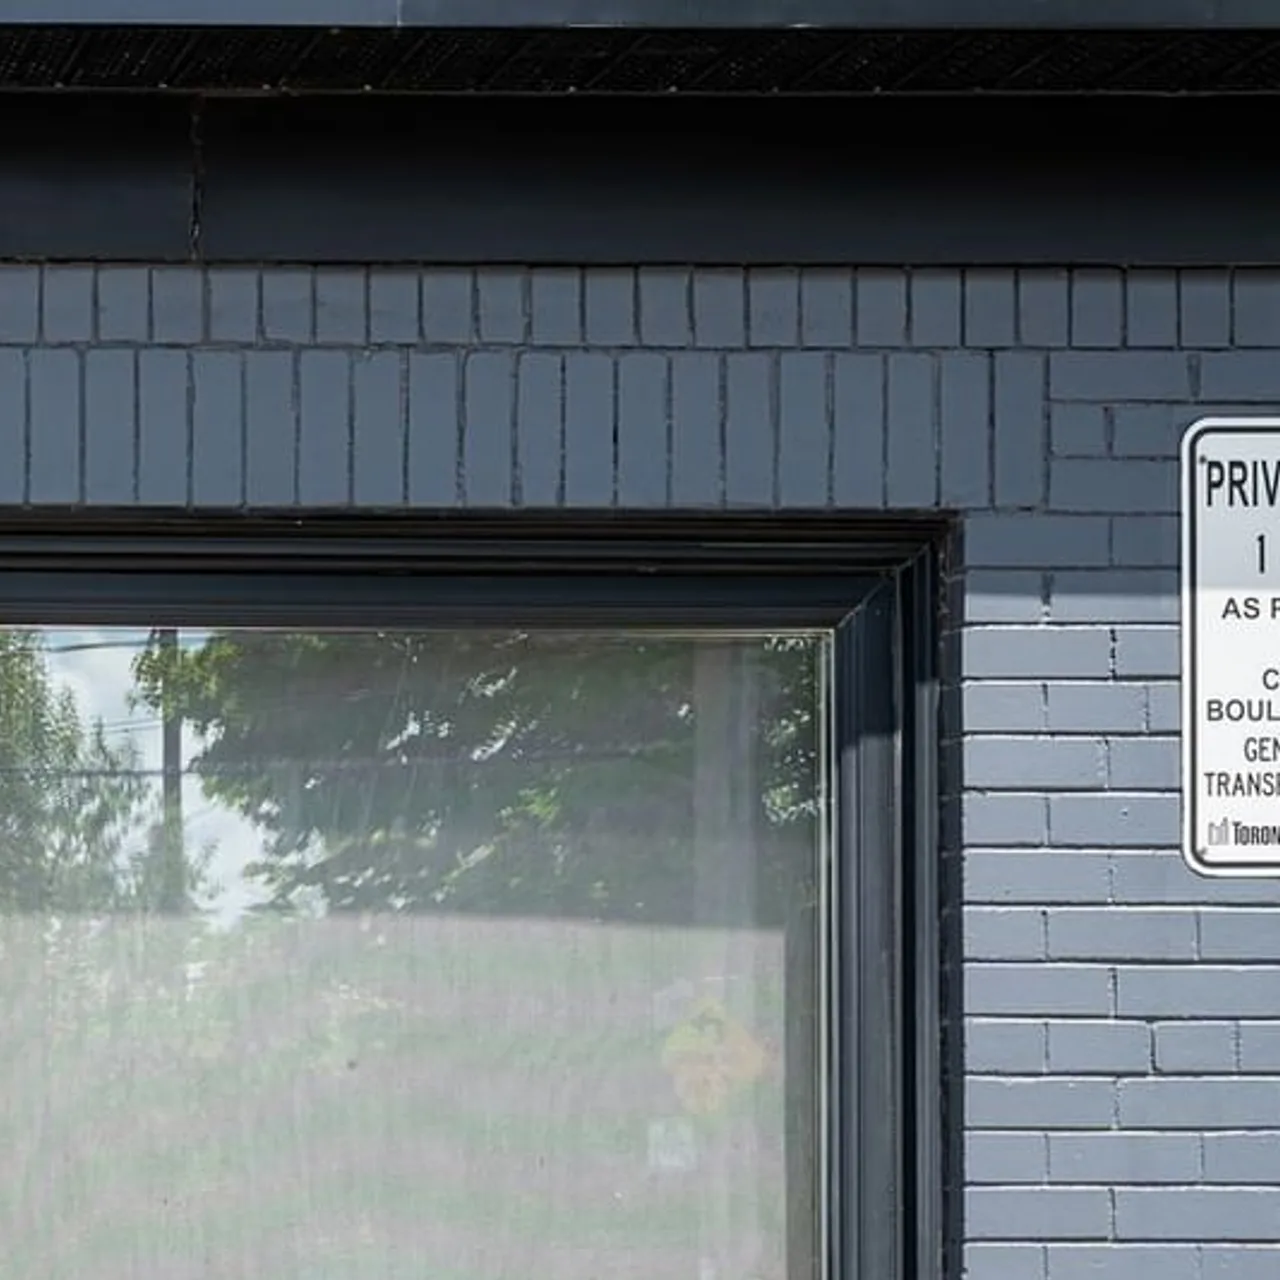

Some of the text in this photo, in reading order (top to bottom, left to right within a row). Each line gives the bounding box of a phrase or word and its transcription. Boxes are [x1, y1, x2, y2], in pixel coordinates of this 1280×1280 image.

[1206, 460, 1280, 507] PRIV
[1221, 597, 1260, 619] AS
[1207, 699, 1280, 722] BOUL
